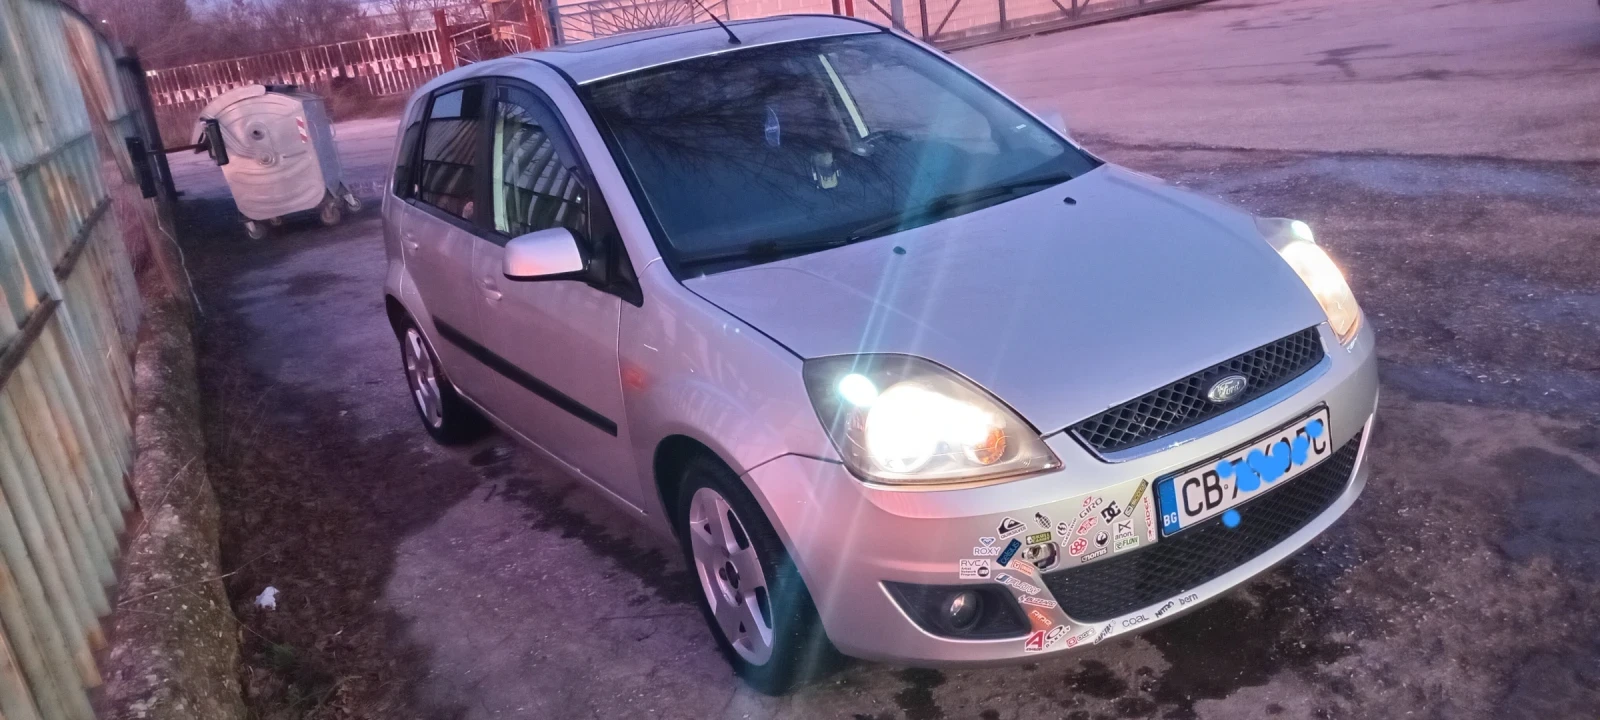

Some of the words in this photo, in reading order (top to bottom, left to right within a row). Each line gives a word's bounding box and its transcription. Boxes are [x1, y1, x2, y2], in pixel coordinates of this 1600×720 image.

[1217, 380, 1240, 395] Ford
[1182, 468, 1224, 517] CB
[1079, 497, 1103, 518] GIRO
[1163, 511, 1178, 528] BG
[974, 547, 1000, 555] ROXY
[1070, 537, 1088, 556] 686
[1178, 593, 1199, 606] bern
[1154, 600, 1175, 619] NITRO
[1045, 625, 1070, 649] OAKLEY
